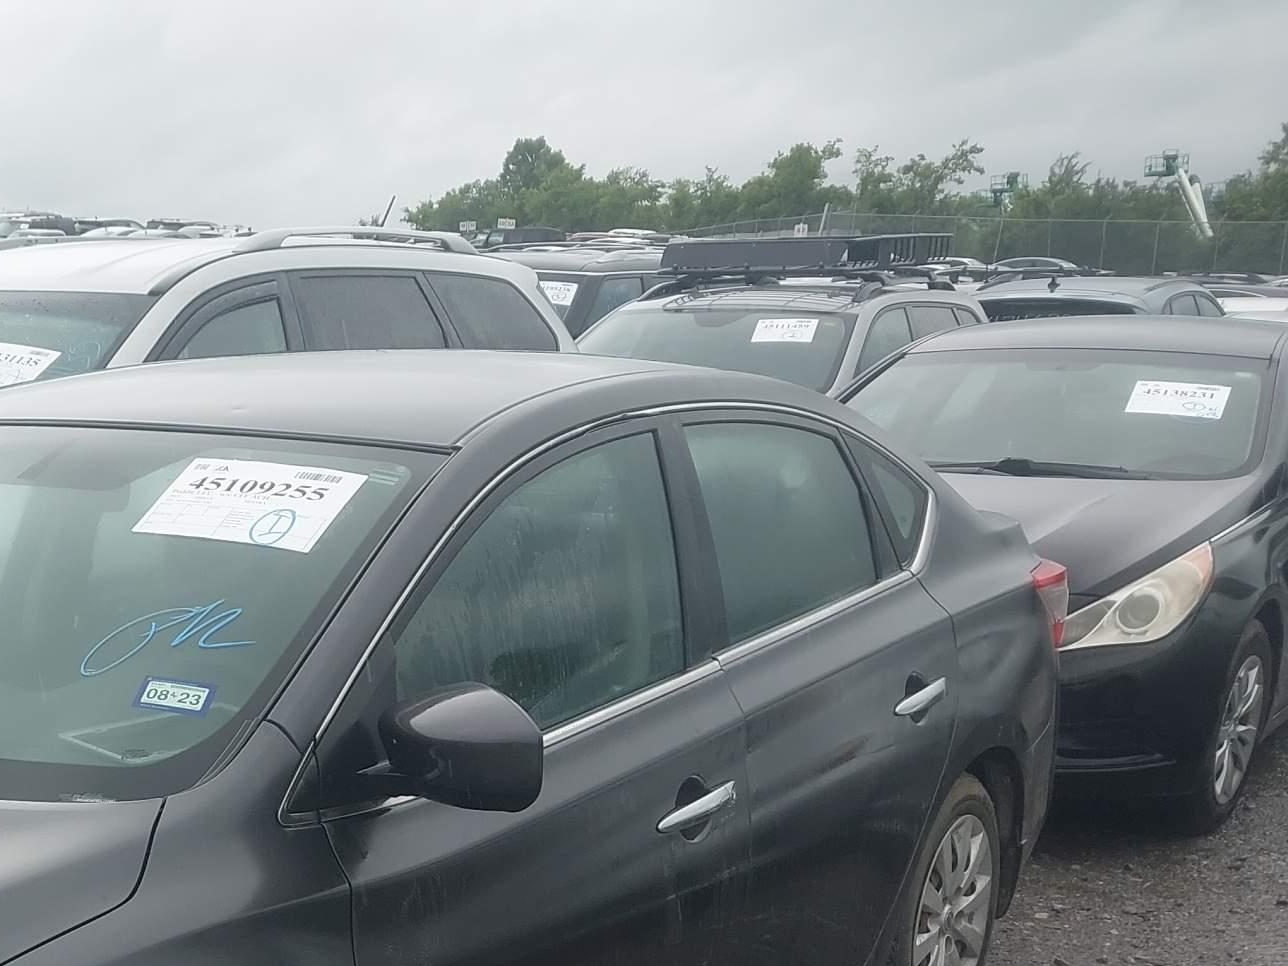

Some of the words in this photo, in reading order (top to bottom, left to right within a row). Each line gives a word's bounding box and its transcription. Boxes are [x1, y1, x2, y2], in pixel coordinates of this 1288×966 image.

[1143, 388, 1215, 399] 45138231
[189, 476, 330, 501] 45109255
[146, 688, 170, 701] 08
[177, 692, 202, 706] 23
